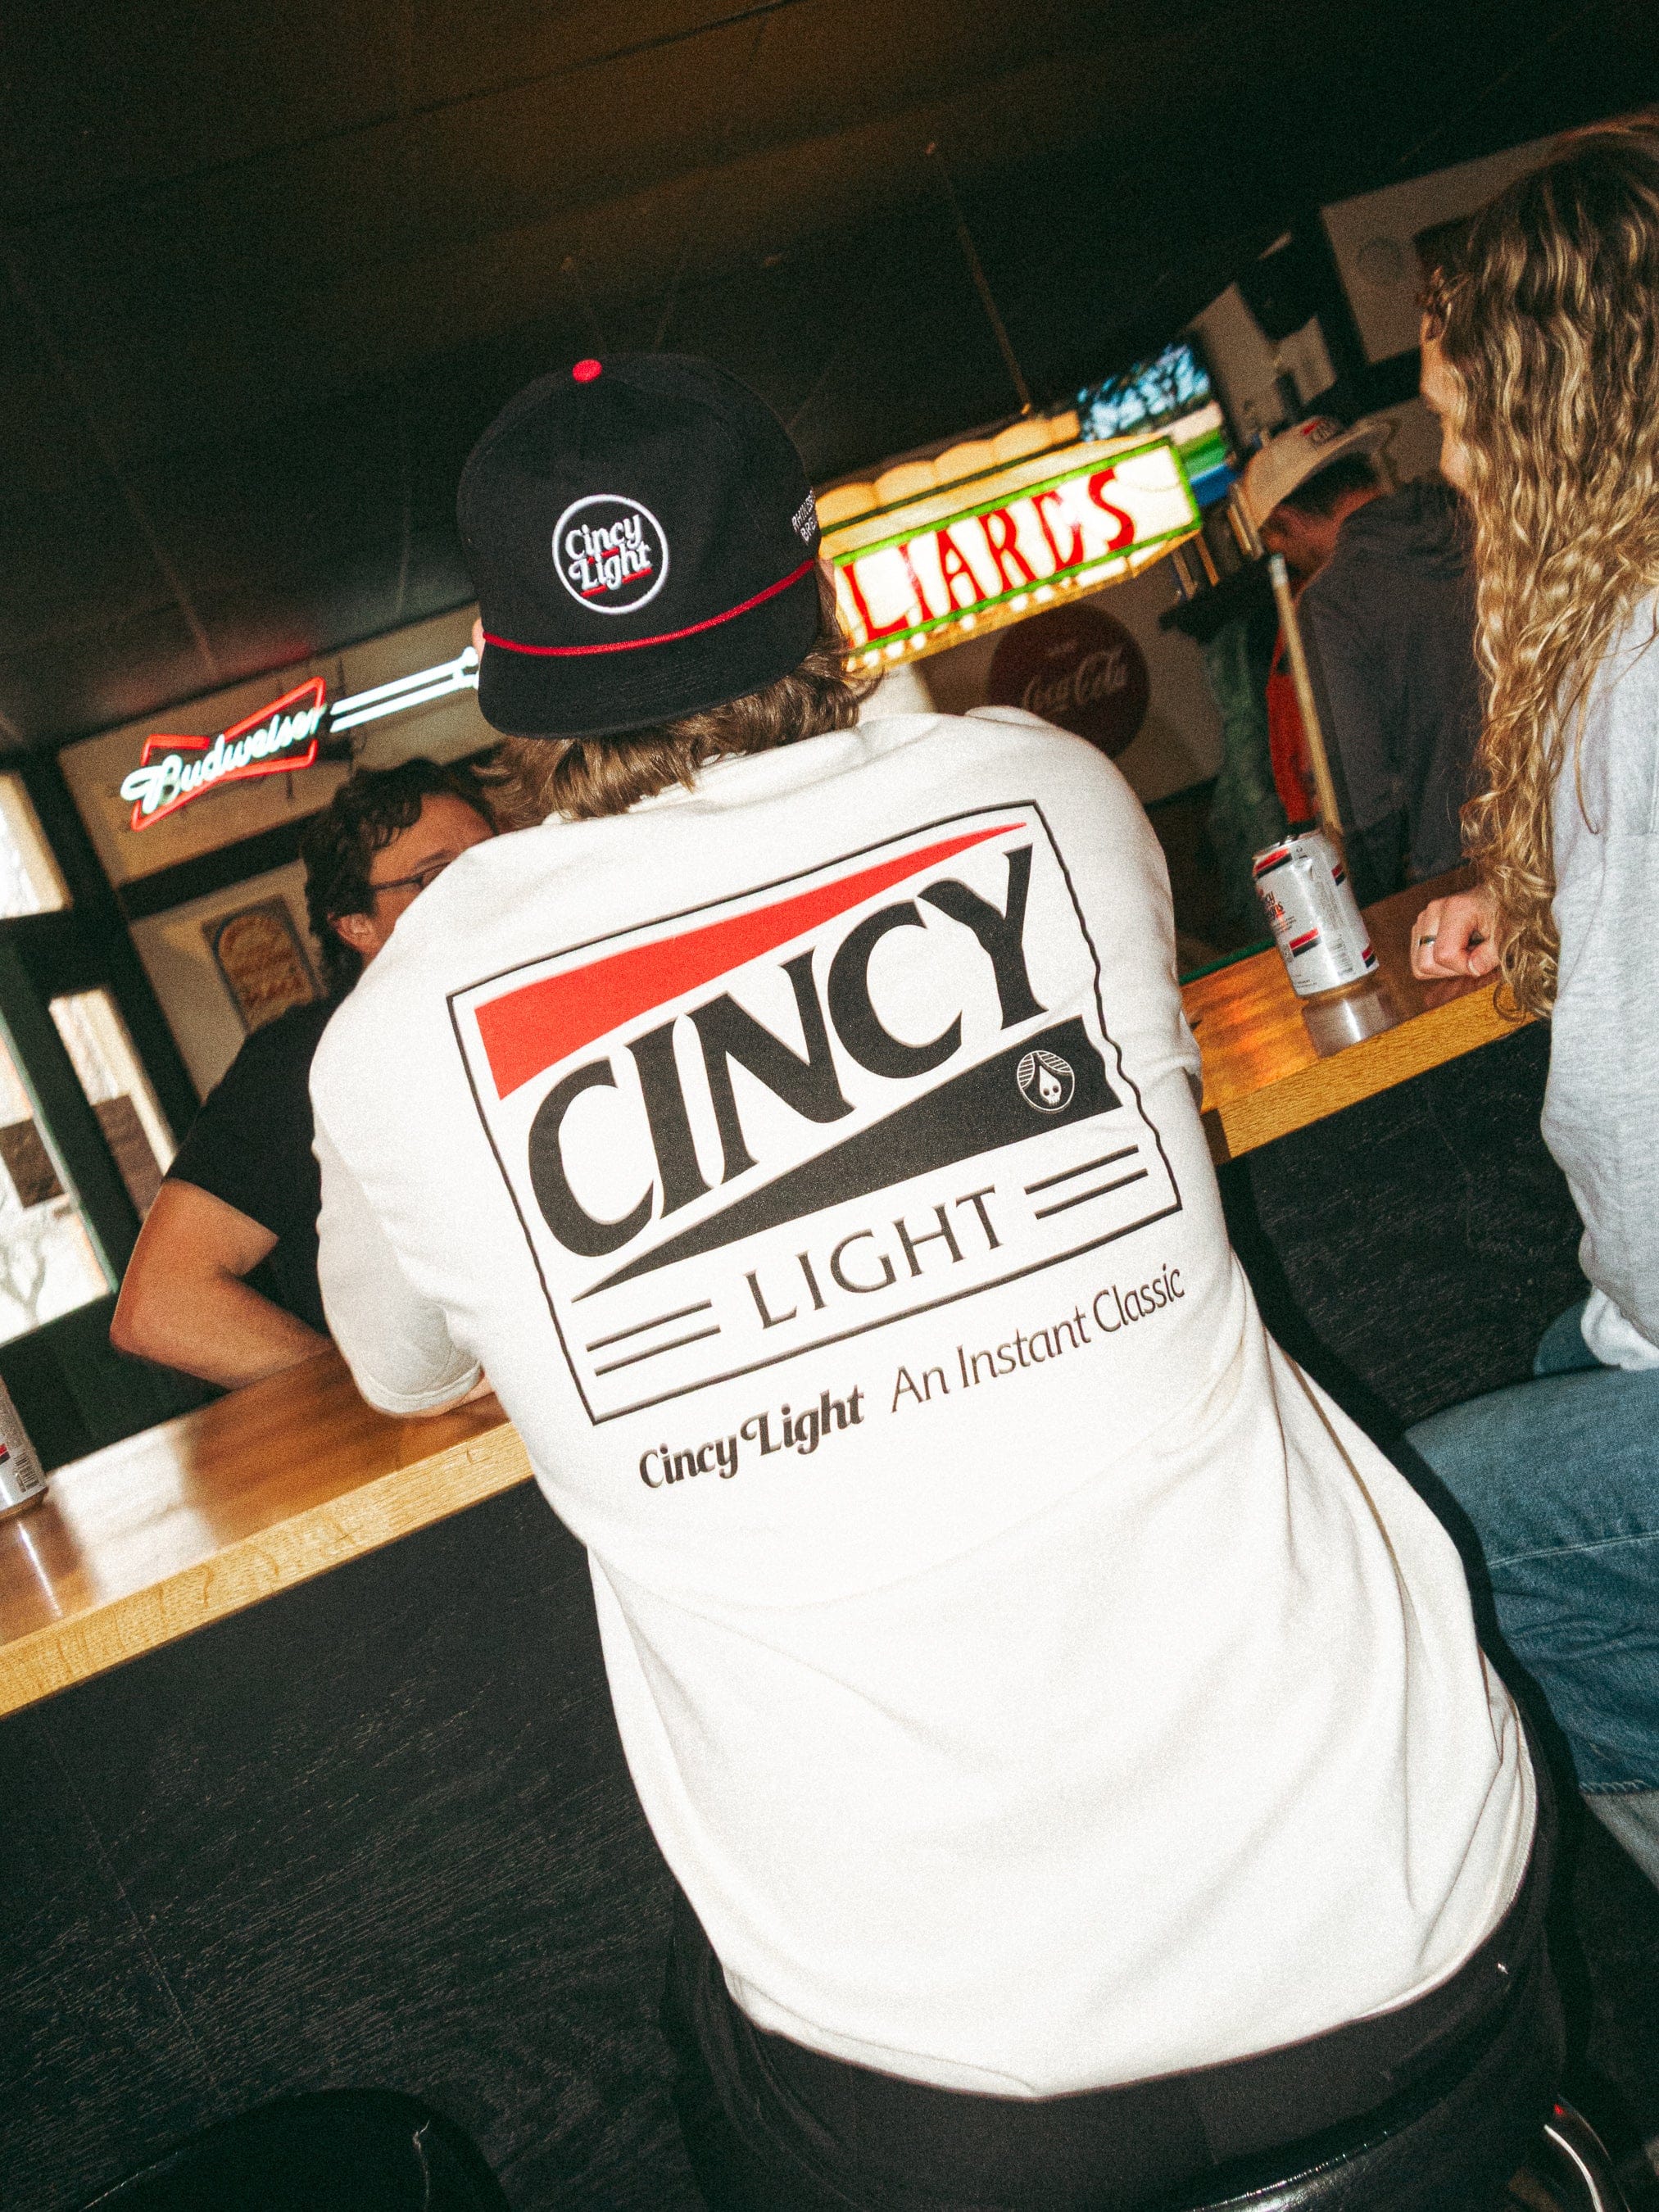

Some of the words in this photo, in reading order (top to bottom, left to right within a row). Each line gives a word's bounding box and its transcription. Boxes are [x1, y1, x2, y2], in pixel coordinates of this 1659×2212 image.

[565, 514, 642, 551] Cincy
[568, 541, 653, 591] Light
[120, 703, 327, 814] Budweiser
[527, 843, 1049, 1258] CINCY
[746, 1185, 1000, 1330] LIGHT
[638, 1434, 739, 1489] Cincy
[740, 1384, 865, 1455] Light
[891, 1367, 951, 1413] An
[955, 1305, 1092, 1389] Instant
[1091, 1262, 1185, 1334] Classic
